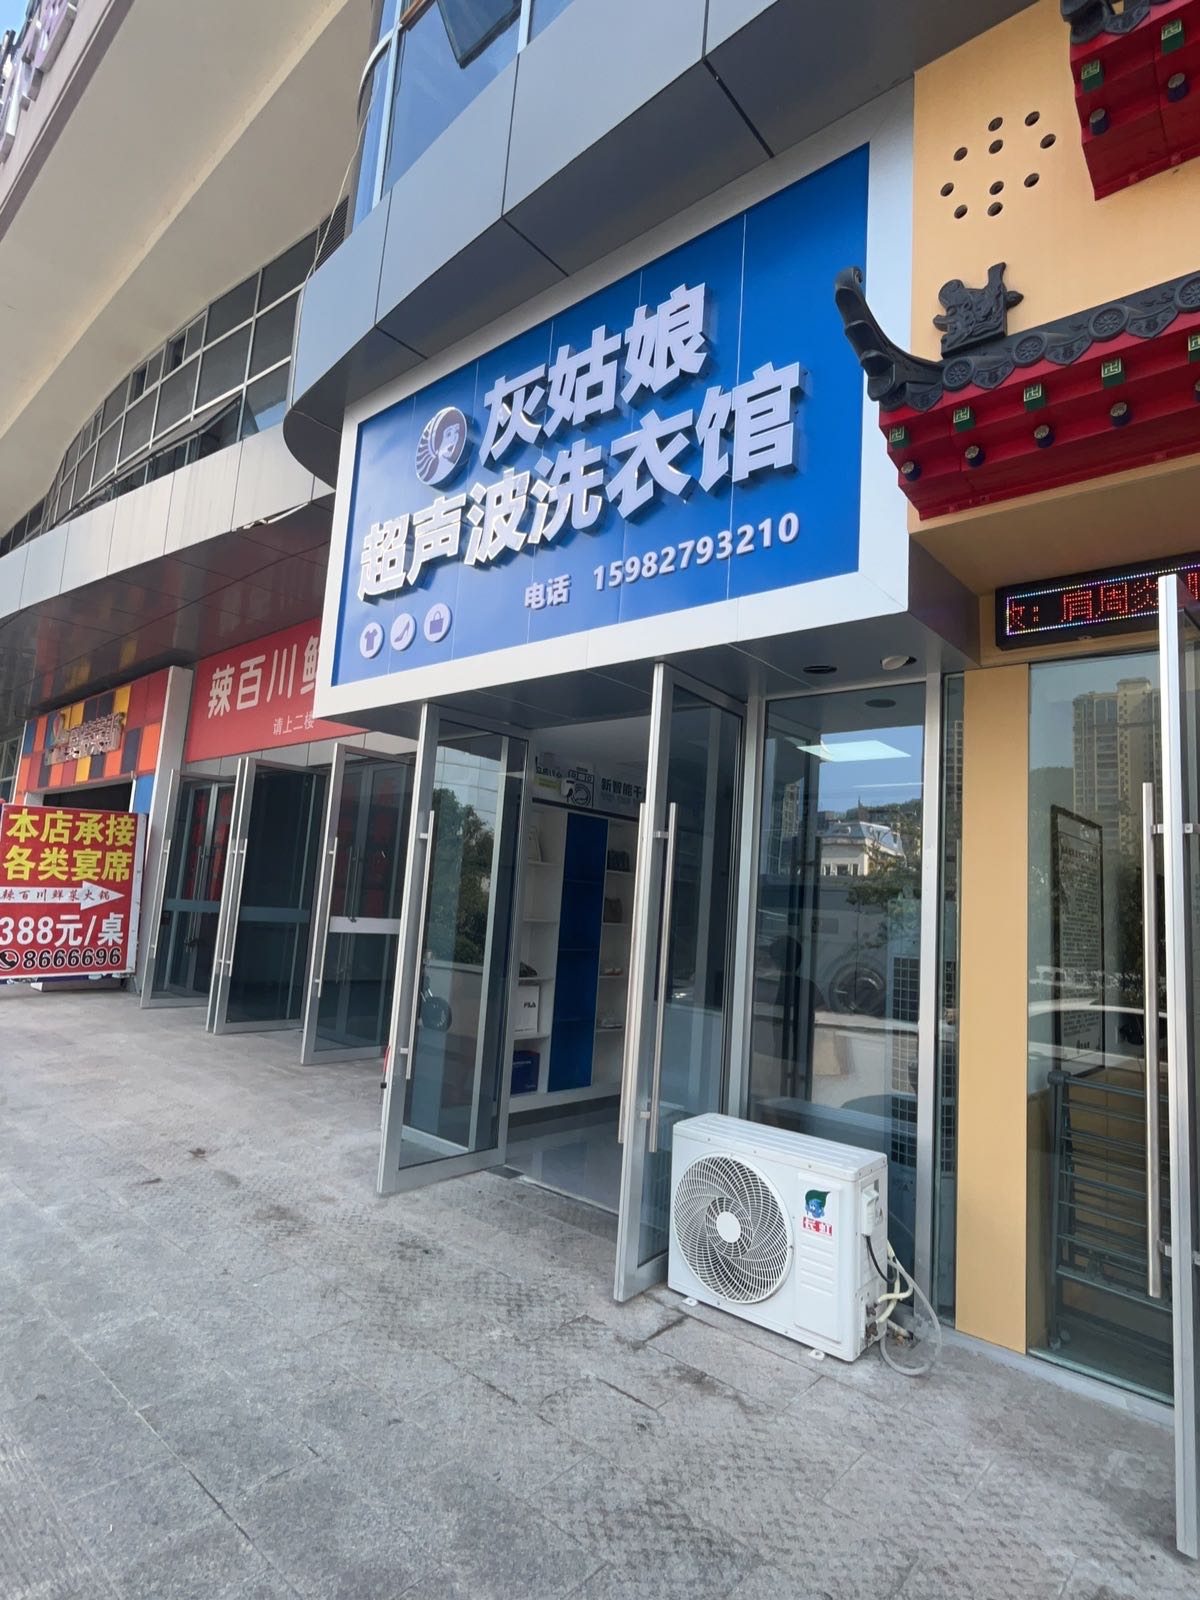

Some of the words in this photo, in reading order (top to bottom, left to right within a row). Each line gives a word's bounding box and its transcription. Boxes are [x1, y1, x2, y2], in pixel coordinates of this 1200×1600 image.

[478, 282, 708, 464] 灰姑娘
[357, 361, 801, 601] 超声波洗衣馆
[523, 574, 571, 610] 电话
[593, 511, 800, 591] 15982793210
[6, 808, 135, 847] 本店承接
[3, 845, 133, 883] 各类宴席
[0, 911, 125, 947] 388元/桌
[23, 946, 122, 970] 8666696
